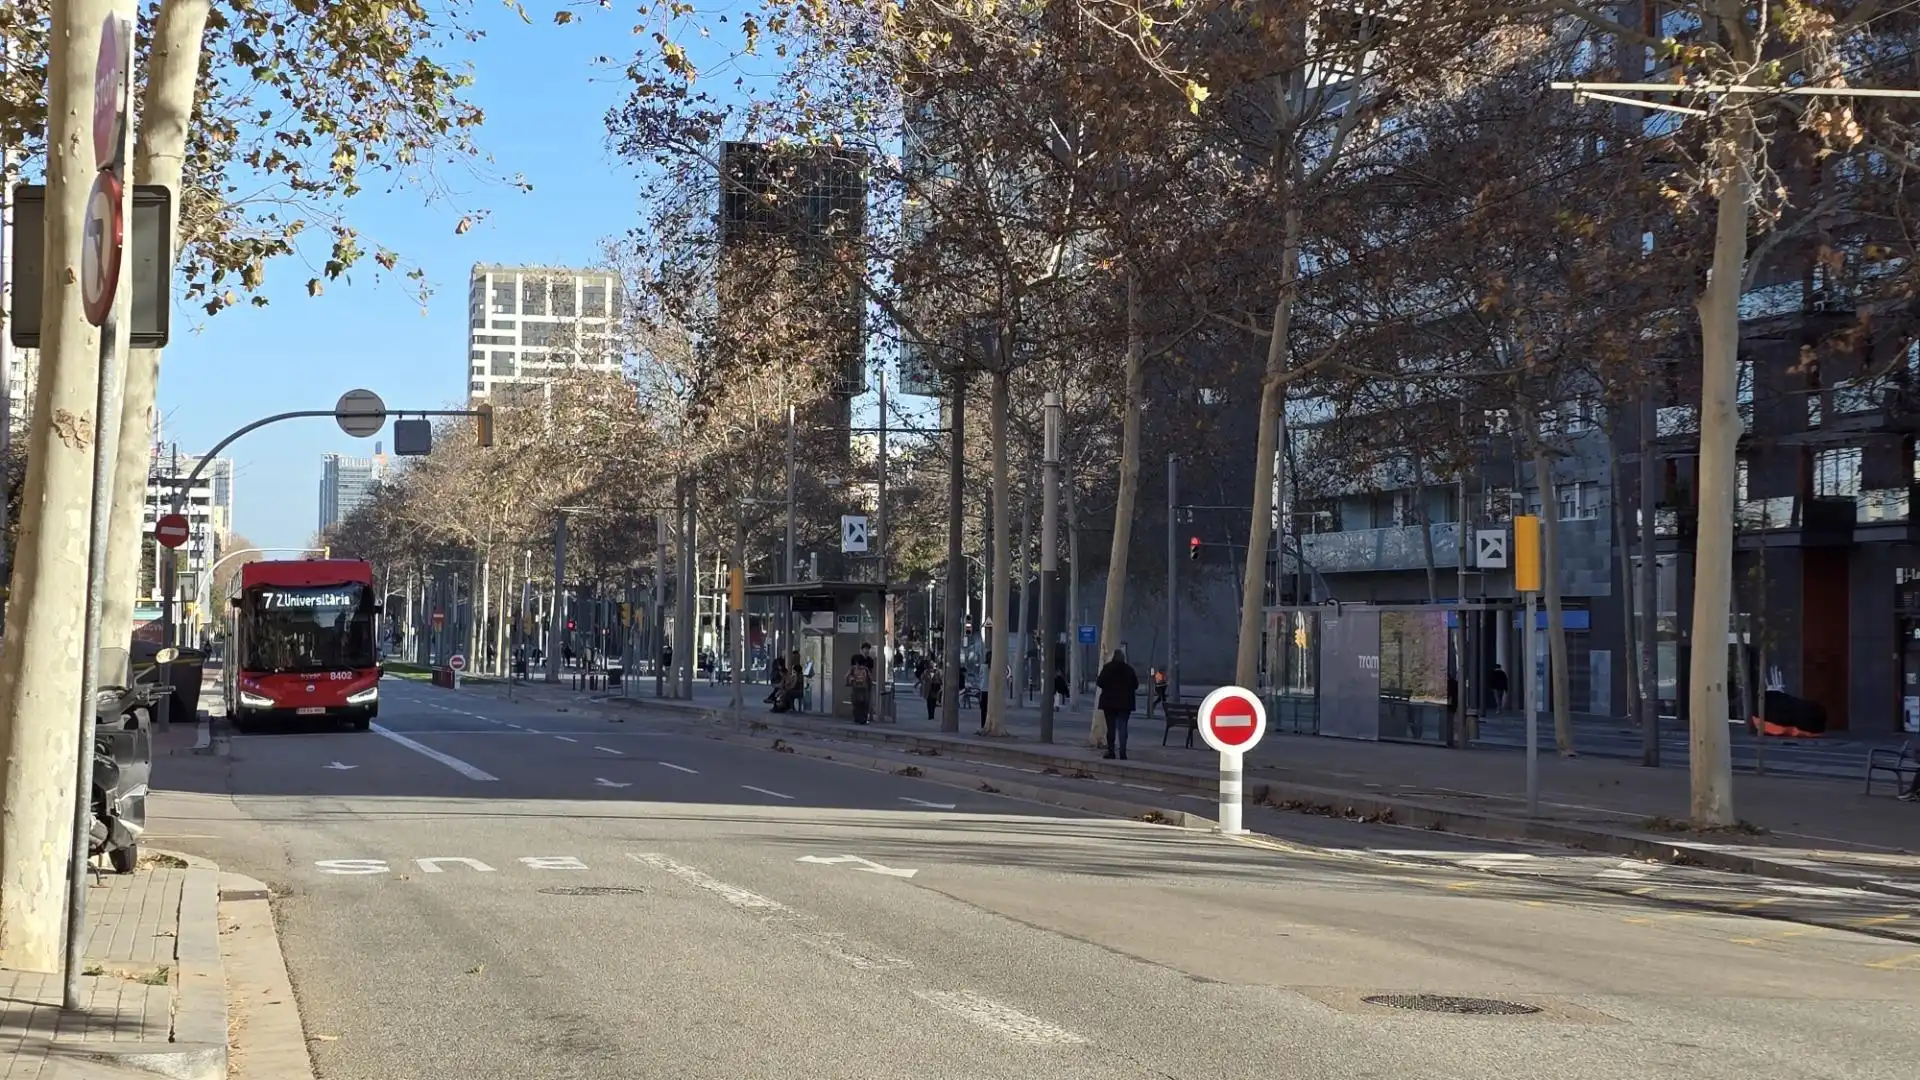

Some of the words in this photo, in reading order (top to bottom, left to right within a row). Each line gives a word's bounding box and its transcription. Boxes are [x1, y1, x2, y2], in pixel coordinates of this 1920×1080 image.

[95, 68, 116, 116] STOP
[262, 592, 274, 609] 7
[330, 671, 352, 680] 8402
[314, 856, 589, 874] BUS
